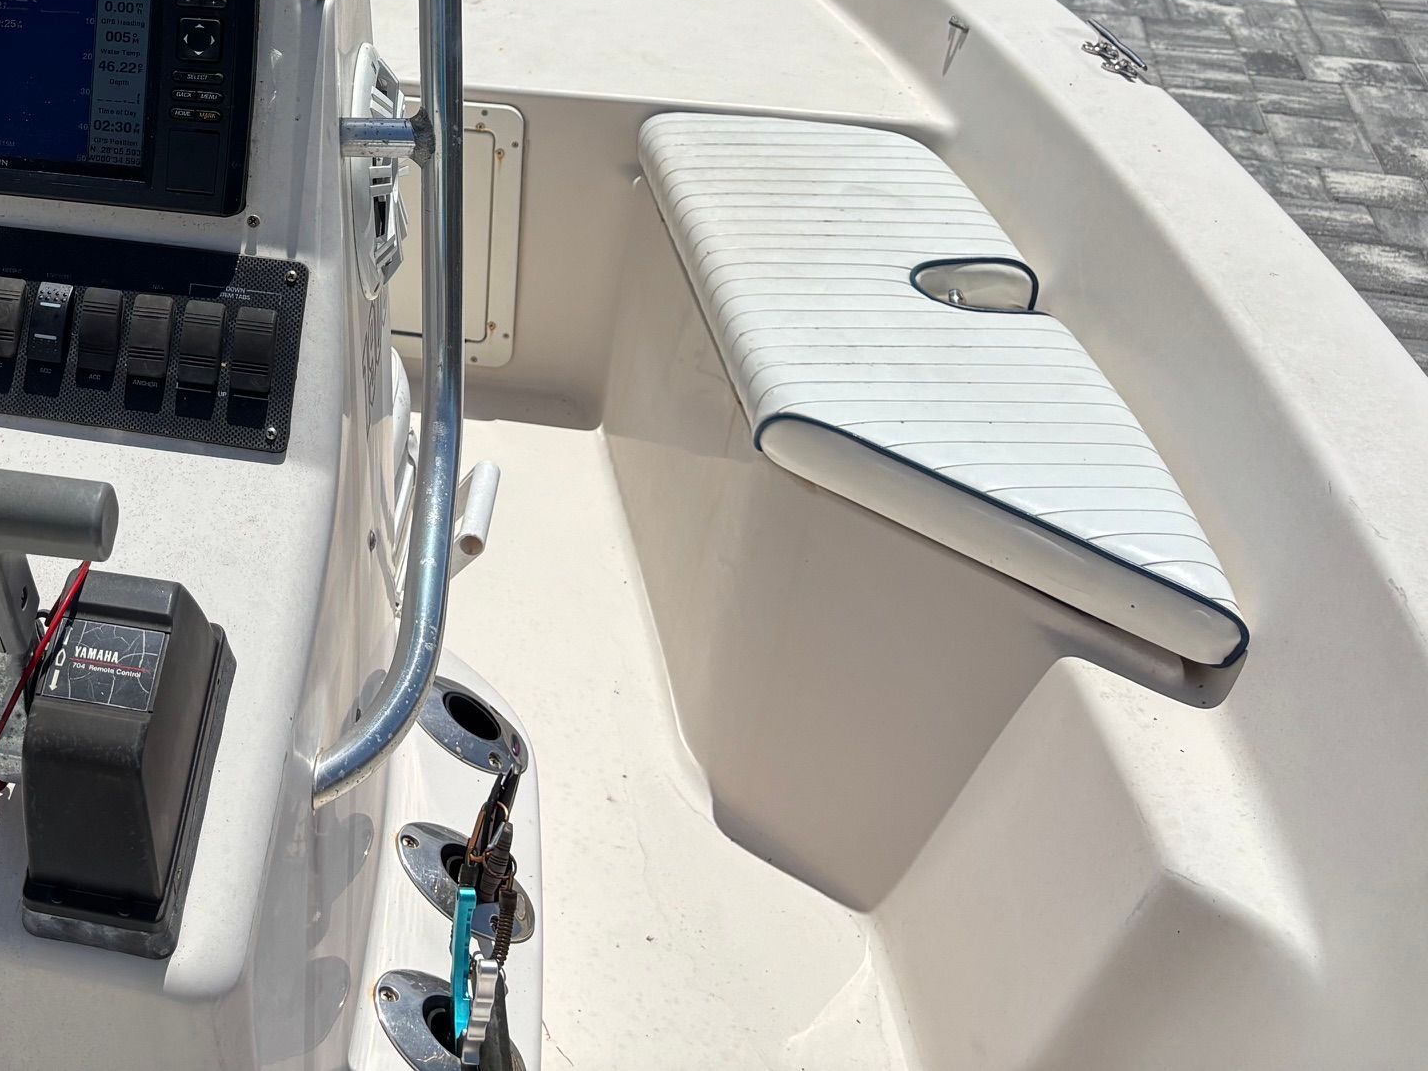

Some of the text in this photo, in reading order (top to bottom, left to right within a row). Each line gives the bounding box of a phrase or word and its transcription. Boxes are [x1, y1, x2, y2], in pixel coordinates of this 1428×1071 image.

[199, 111, 216, 119] MARK
[225, 286, 246, 294] DOWN
[235, 293, 251, 301] TABS
[88, 373, 101, 381] ACC
[132, 379, 158, 388] ANCHOR
[74, 645, 120, 664] YAMAHA
[72, 661, 142, 678] 704 Remote Control
